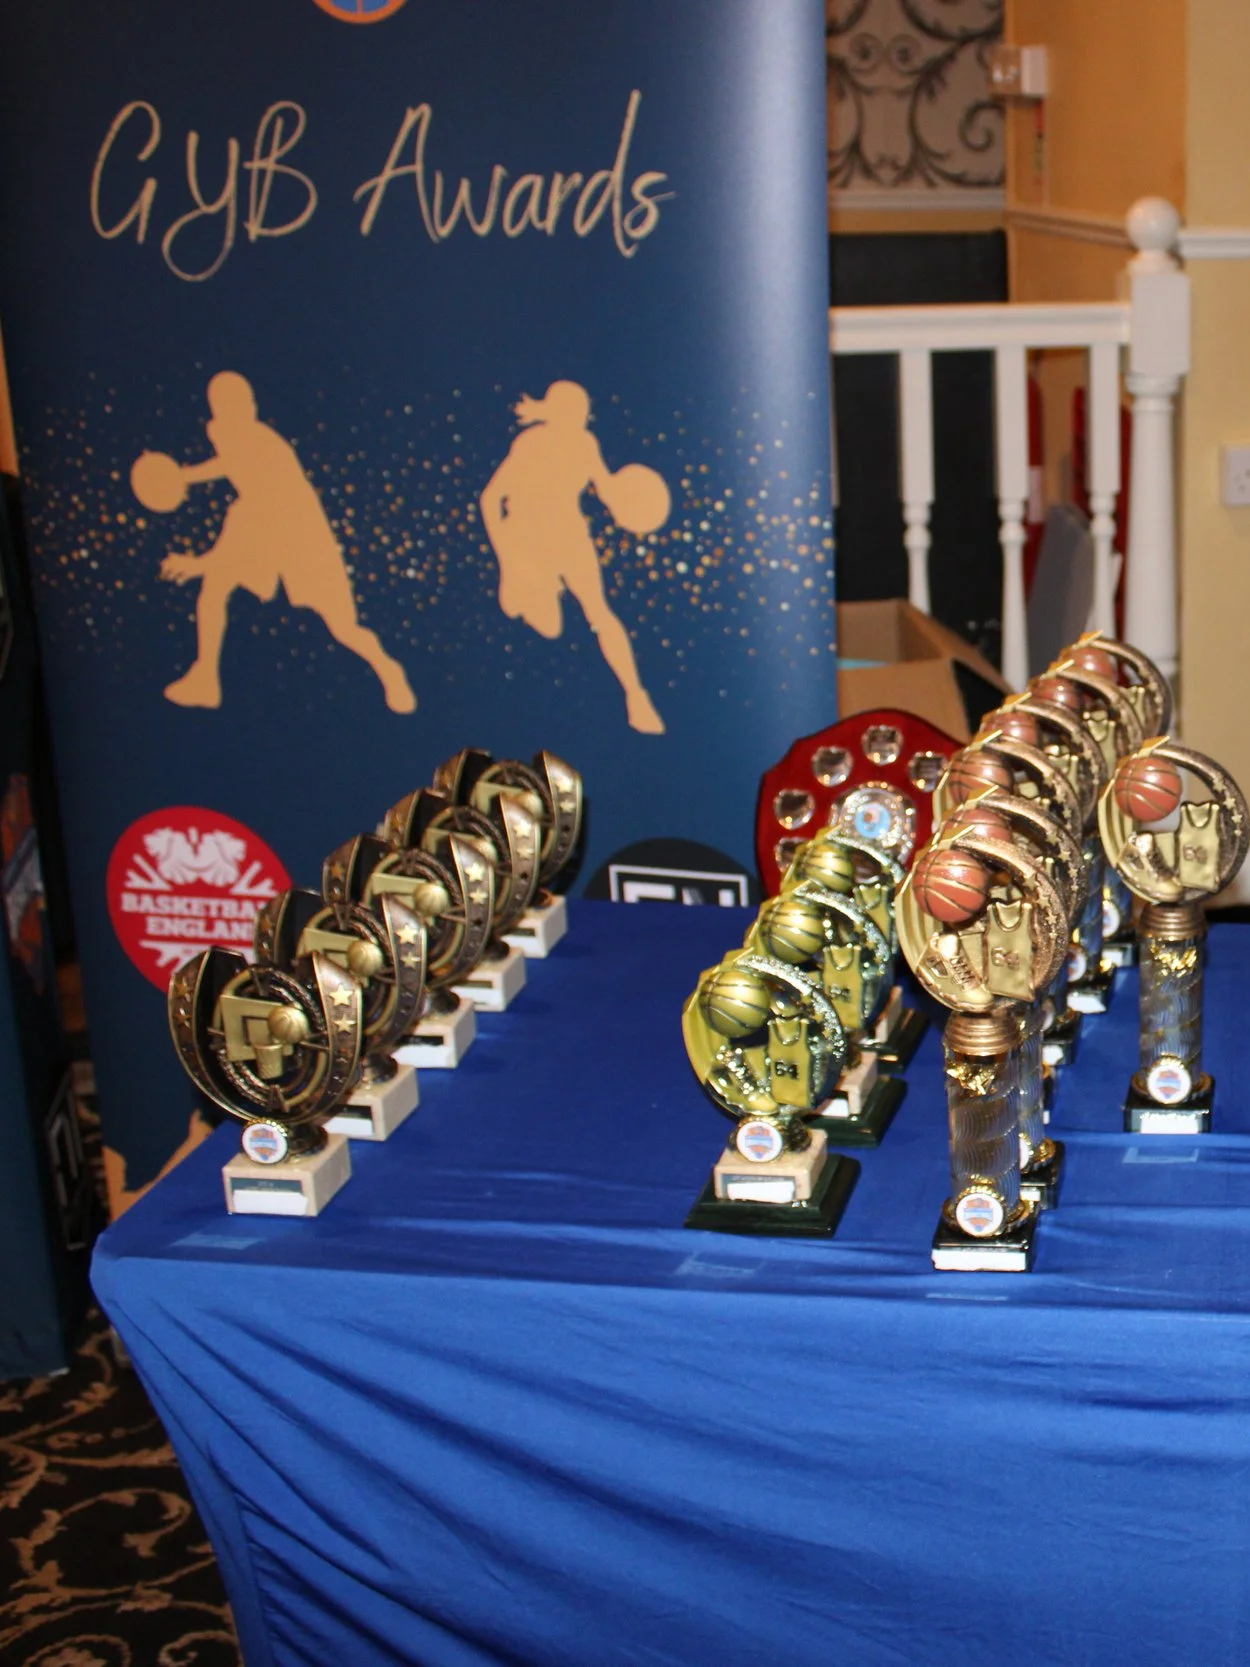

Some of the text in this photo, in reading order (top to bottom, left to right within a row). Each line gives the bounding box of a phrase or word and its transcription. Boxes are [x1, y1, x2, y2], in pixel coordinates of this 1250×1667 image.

[353, 89, 676, 257] Awards
[121, 892, 266, 920] BASKETBA
[145, 915, 254, 941] ENGLAN
